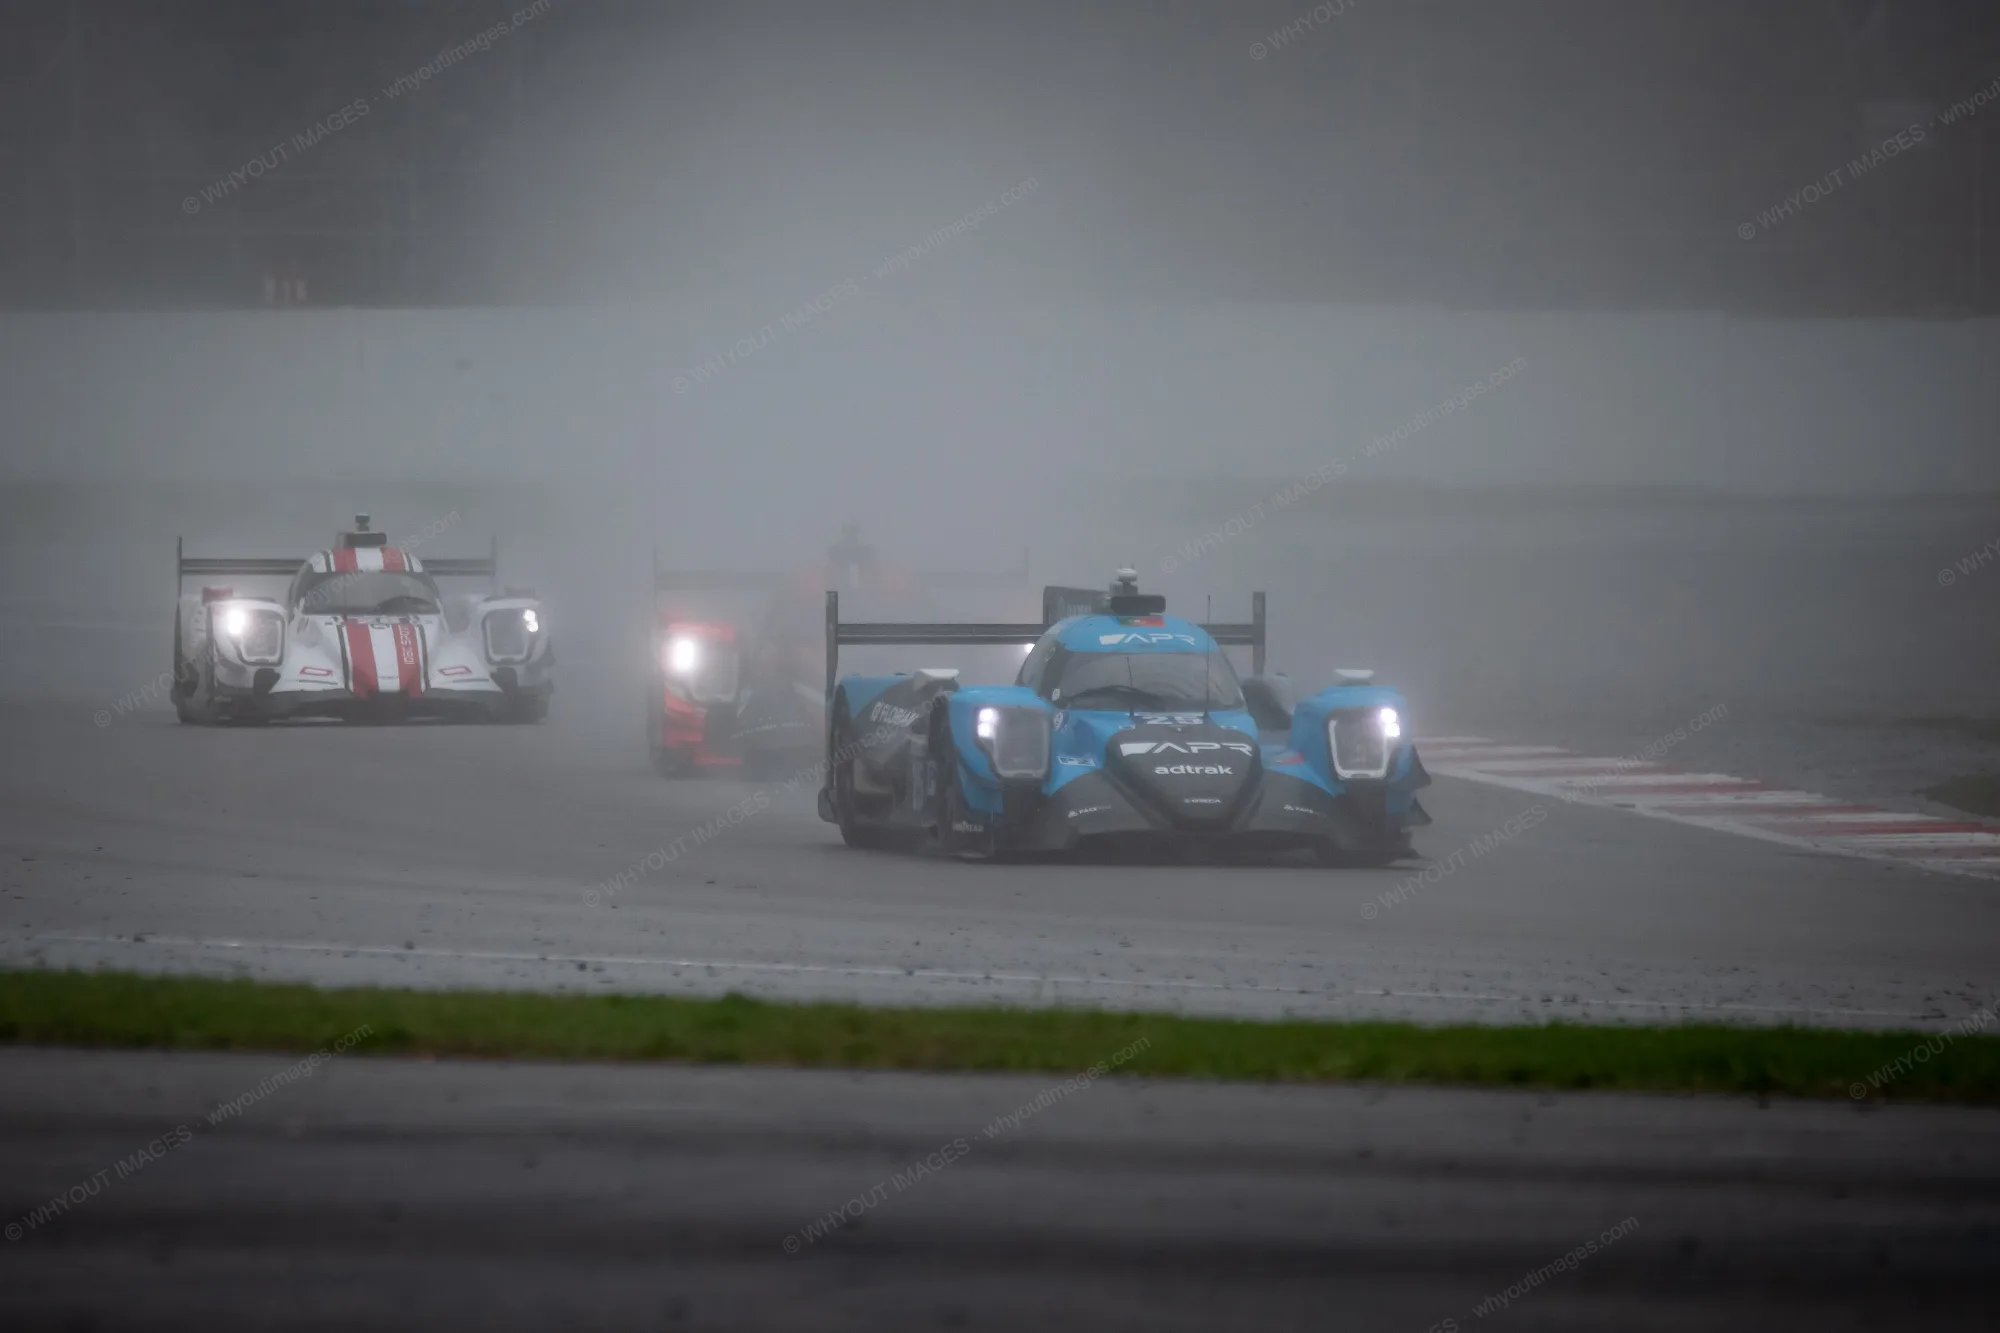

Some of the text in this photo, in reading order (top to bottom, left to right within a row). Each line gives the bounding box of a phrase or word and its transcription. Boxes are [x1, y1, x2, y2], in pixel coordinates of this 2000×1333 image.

[1123, 632, 1196, 646] APR
[1152, 742, 1253, 757] APR
[1154, 765, 1234, 775] adtrak
